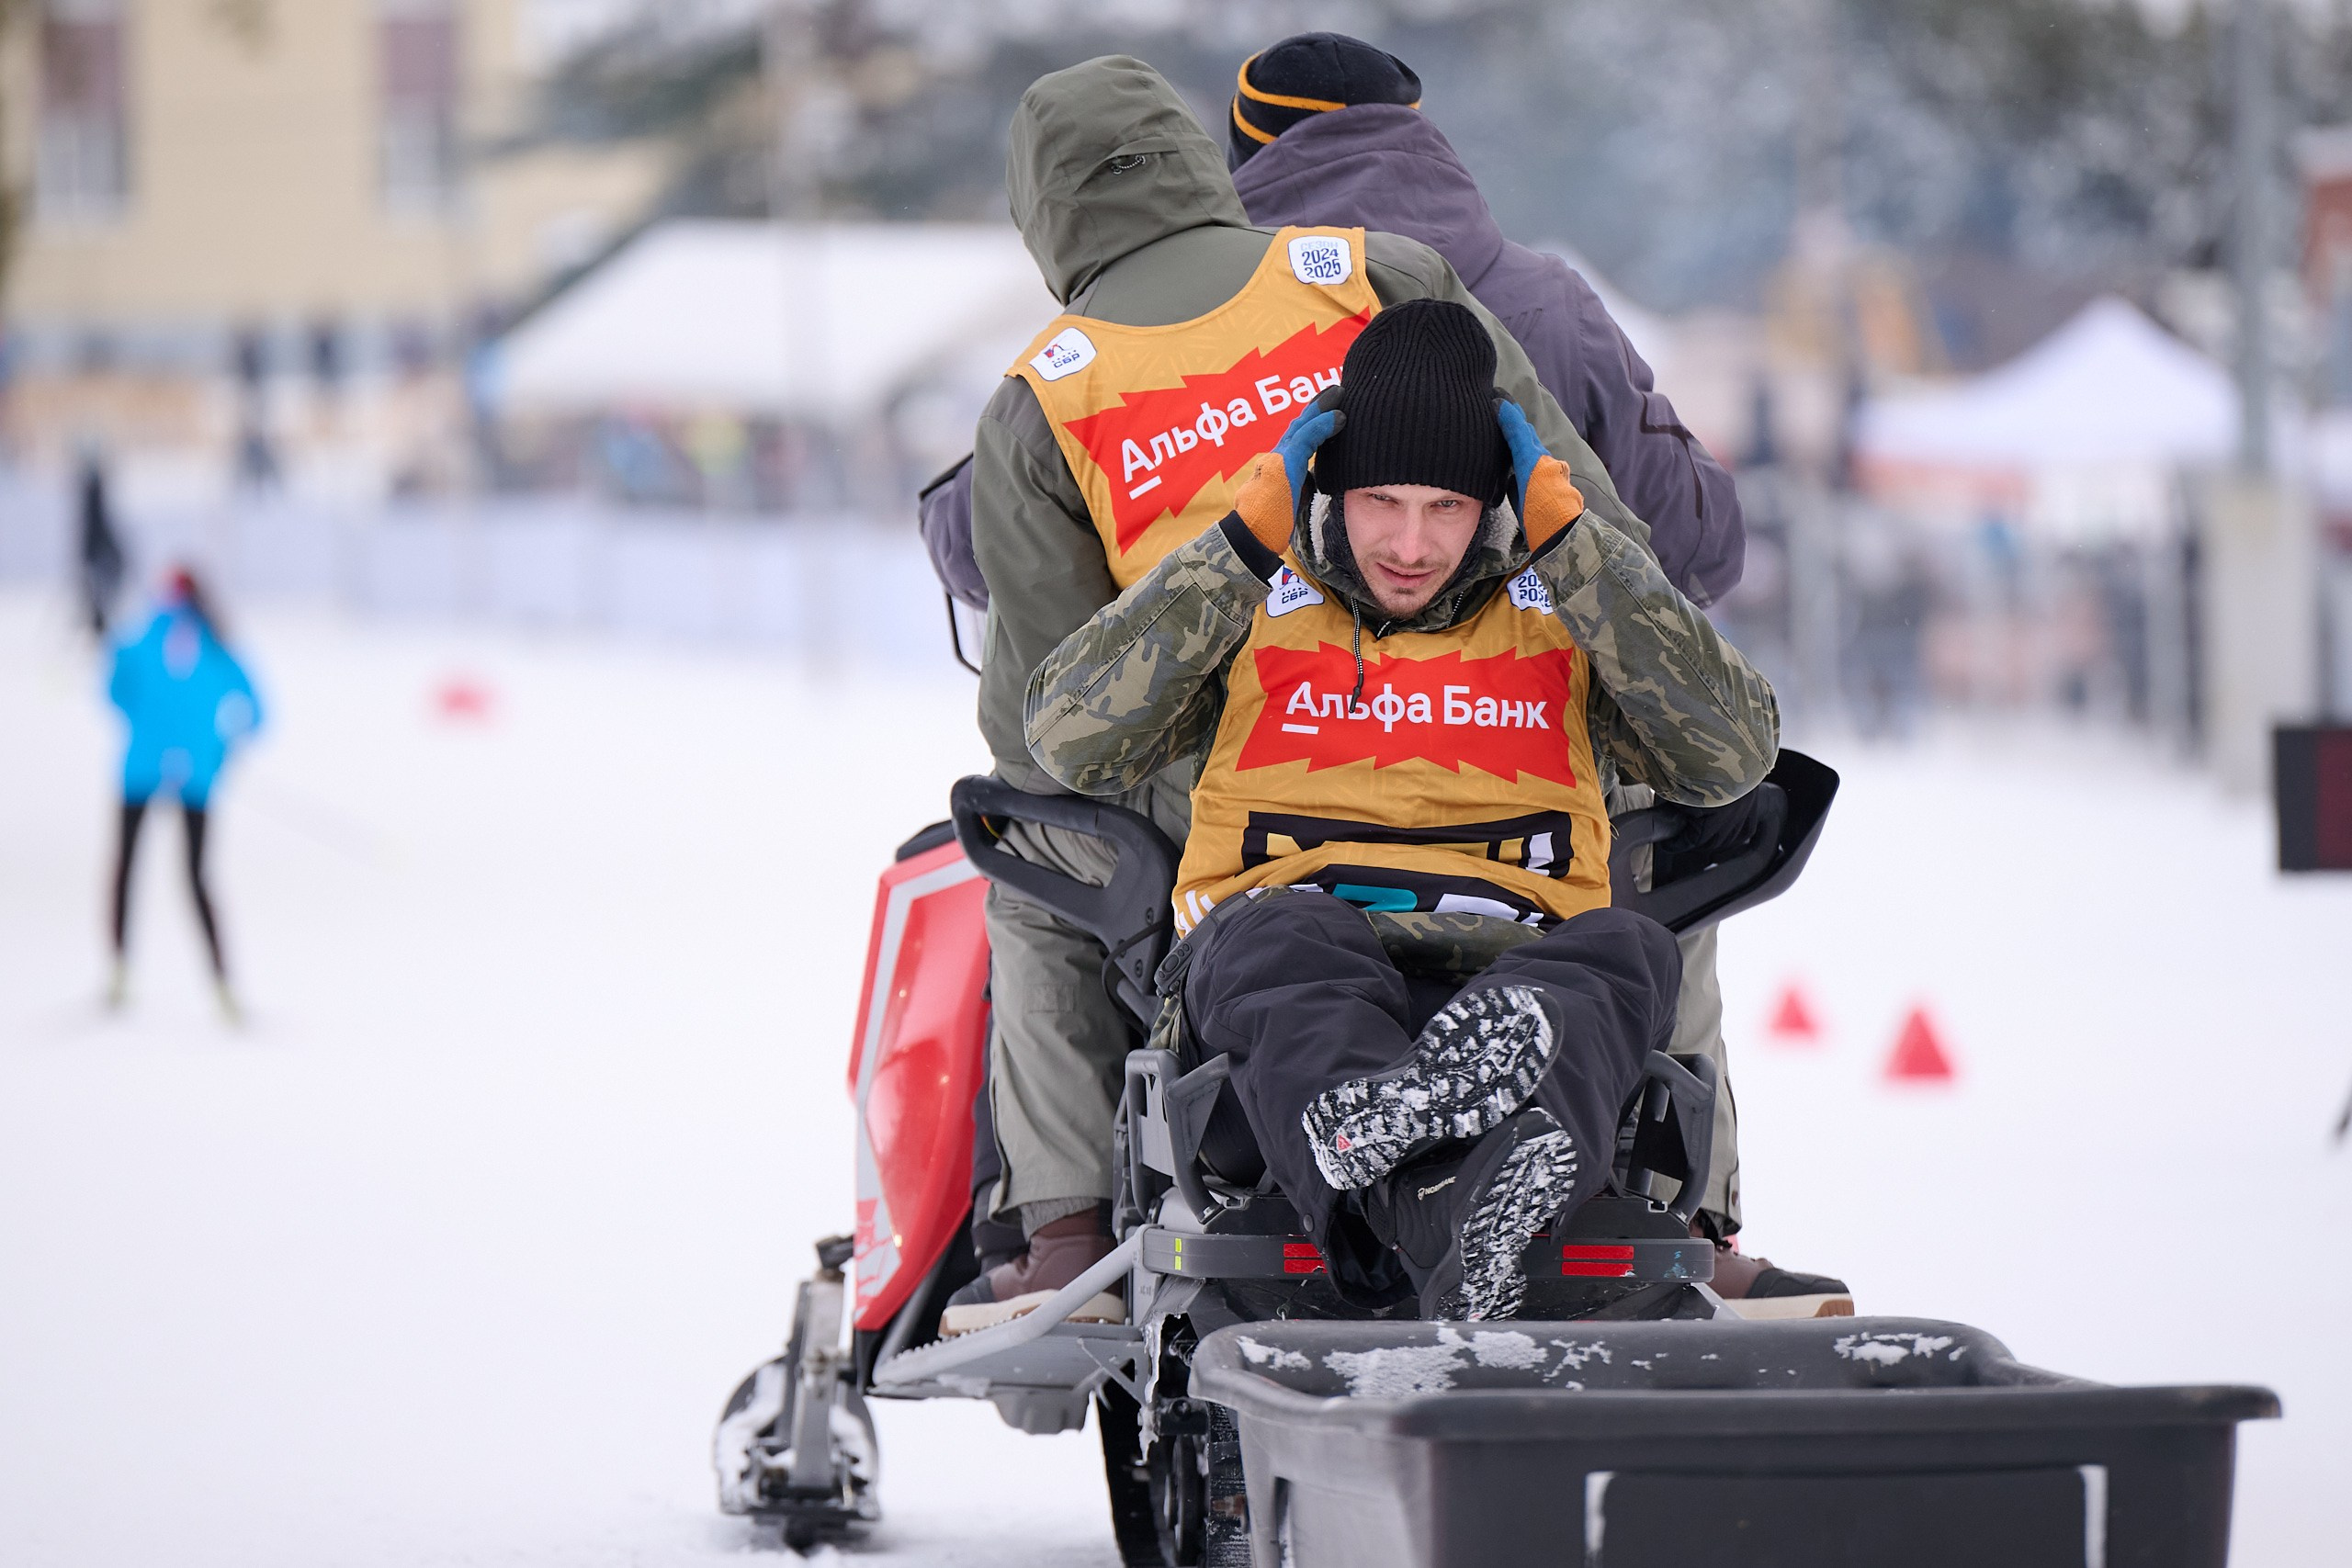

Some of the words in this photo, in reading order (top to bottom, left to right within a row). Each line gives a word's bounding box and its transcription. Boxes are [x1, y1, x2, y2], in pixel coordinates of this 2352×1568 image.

[1302, 247, 1340, 266] 2024
[1305, 258, 1341, 278] 2025
[1054, 353, 1080, 368] СБР
[1120, 395, 1258, 501] Альфа
[1254, 366, 1343, 417] Бан
[1282, 590, 1308, 604] СБР
[1282, 681, 1432, 735] Альфа
[1443, 684, 1550, 730] Банк
